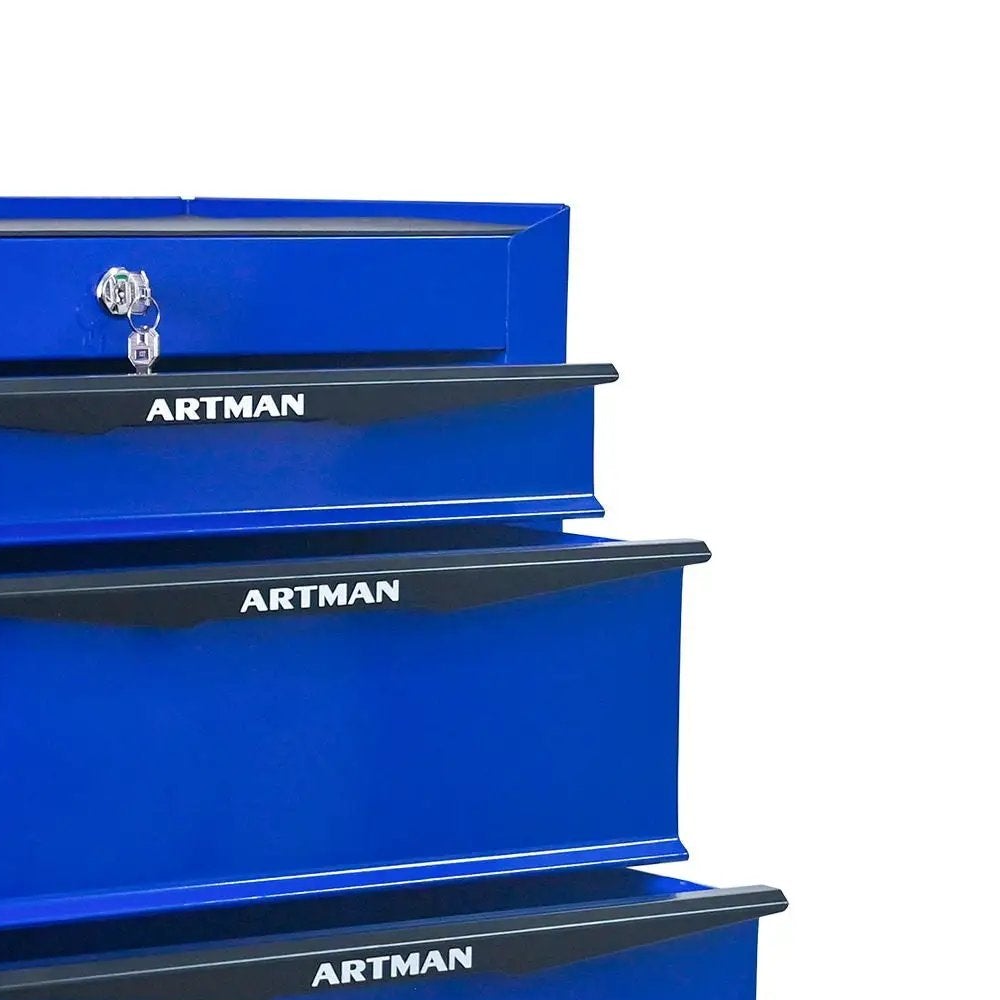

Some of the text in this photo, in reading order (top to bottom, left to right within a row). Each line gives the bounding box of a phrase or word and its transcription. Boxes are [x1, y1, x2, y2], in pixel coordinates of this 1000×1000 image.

[145, 393, 305, 422] ARTMAN
[240, 579, 400, 613] ARTMAN
[311, 945, 473, 988] ARTMAN
